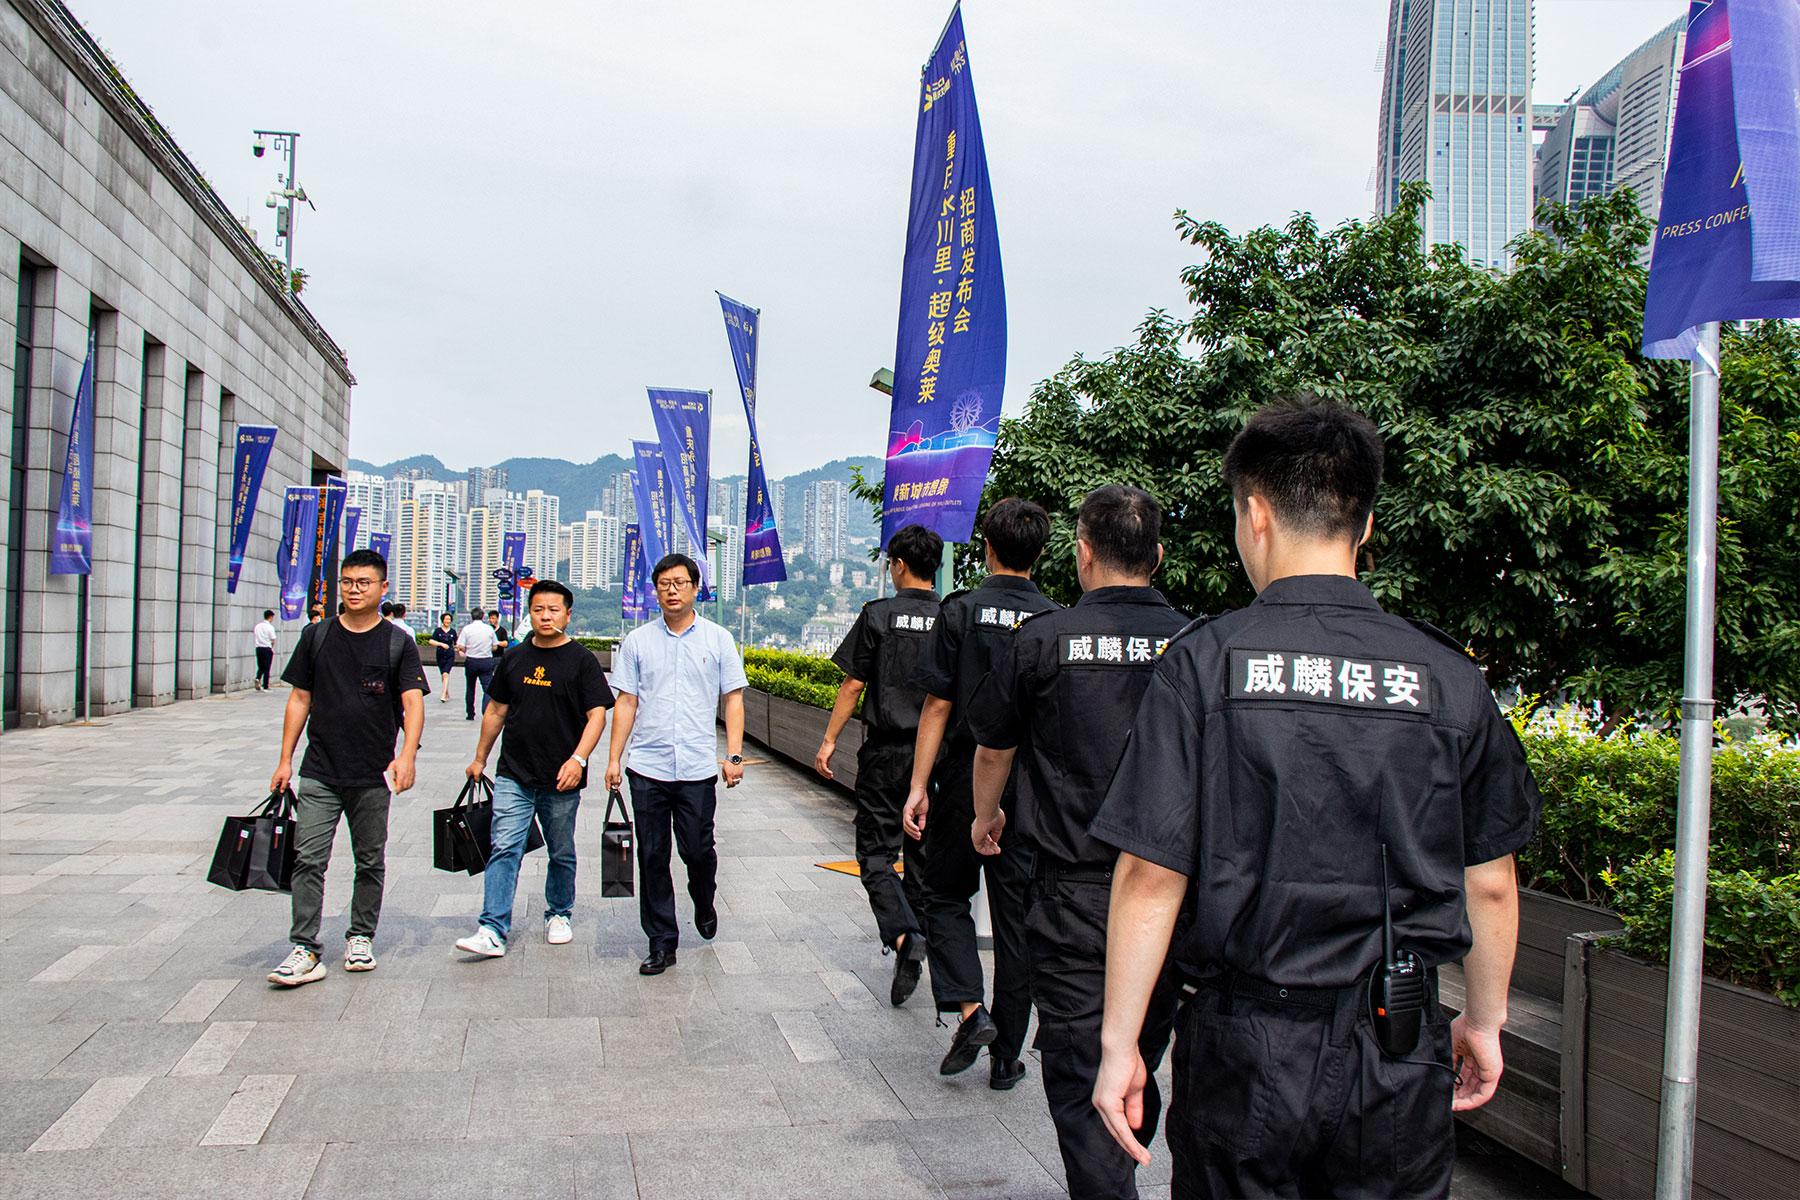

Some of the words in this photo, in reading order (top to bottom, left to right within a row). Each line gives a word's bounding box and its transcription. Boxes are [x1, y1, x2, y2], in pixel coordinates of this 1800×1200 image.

[1662, 219, 1702, 239] PRESS
[953, 187, 975, 334] 招商发布会
[1244, 654, 1421, 707] 威麟保安
